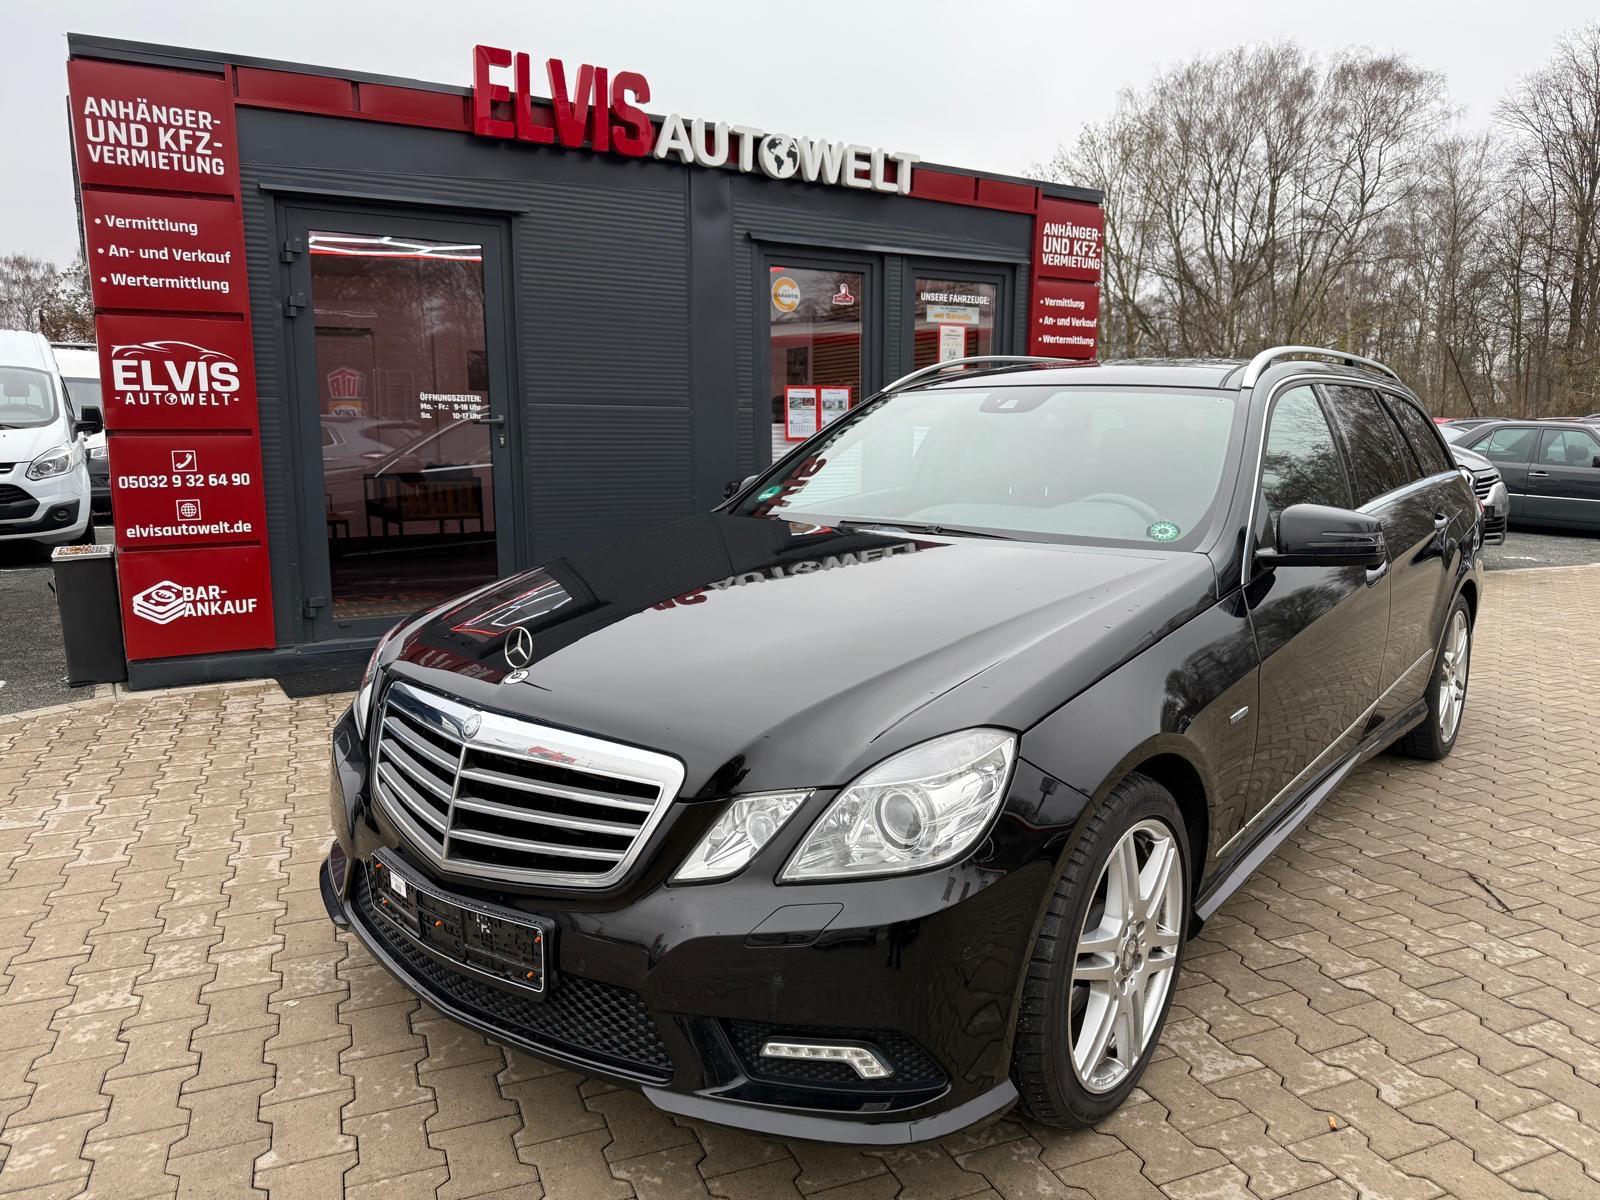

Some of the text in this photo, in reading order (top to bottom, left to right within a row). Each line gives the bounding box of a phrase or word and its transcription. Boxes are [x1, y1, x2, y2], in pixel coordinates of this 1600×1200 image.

[473, 44, 652, 157] ELVIS
[84, 96, 221, 130] ANHÄNGER-
[85, 118, 223, 155] UND KFZ-
[87, 143, 225, 176] VERMIETUNG
[653, 113, 920, 195] AUTOWELT
[105, 214, 198, 236] Vermittlung
[1043, 222, 1102, 241] ANHÄNGER-
[108, 244, 231, 264] An- und Verkauf
[1043, 236, 1101, 257] UND KFZ-
[1042, 253, 1101, 270] VERMIETUNG
[111, 272, 229, 293] Wertermittlung
[921, 292, 990, 305] UNSERE FAHRZEUGE:
[1044, 297, 1085, 310] Vermittlung
[1043, 316, 1097, 328] An- und Verkauf
[1043, 334, 1094, 347] Wertermittlung
[112, 359, 240, 393] ELVIS
[420, 392, 481, 402] ÖFFNUNGSZEITEN:
[118, 473, 250, 489] 05032 9 32 64 90
[126, 520, 252, 538] elvisautowelt.de
[182, 585, 228, 602] BAR-
[183, 598, 257, 618] ANKAUF
